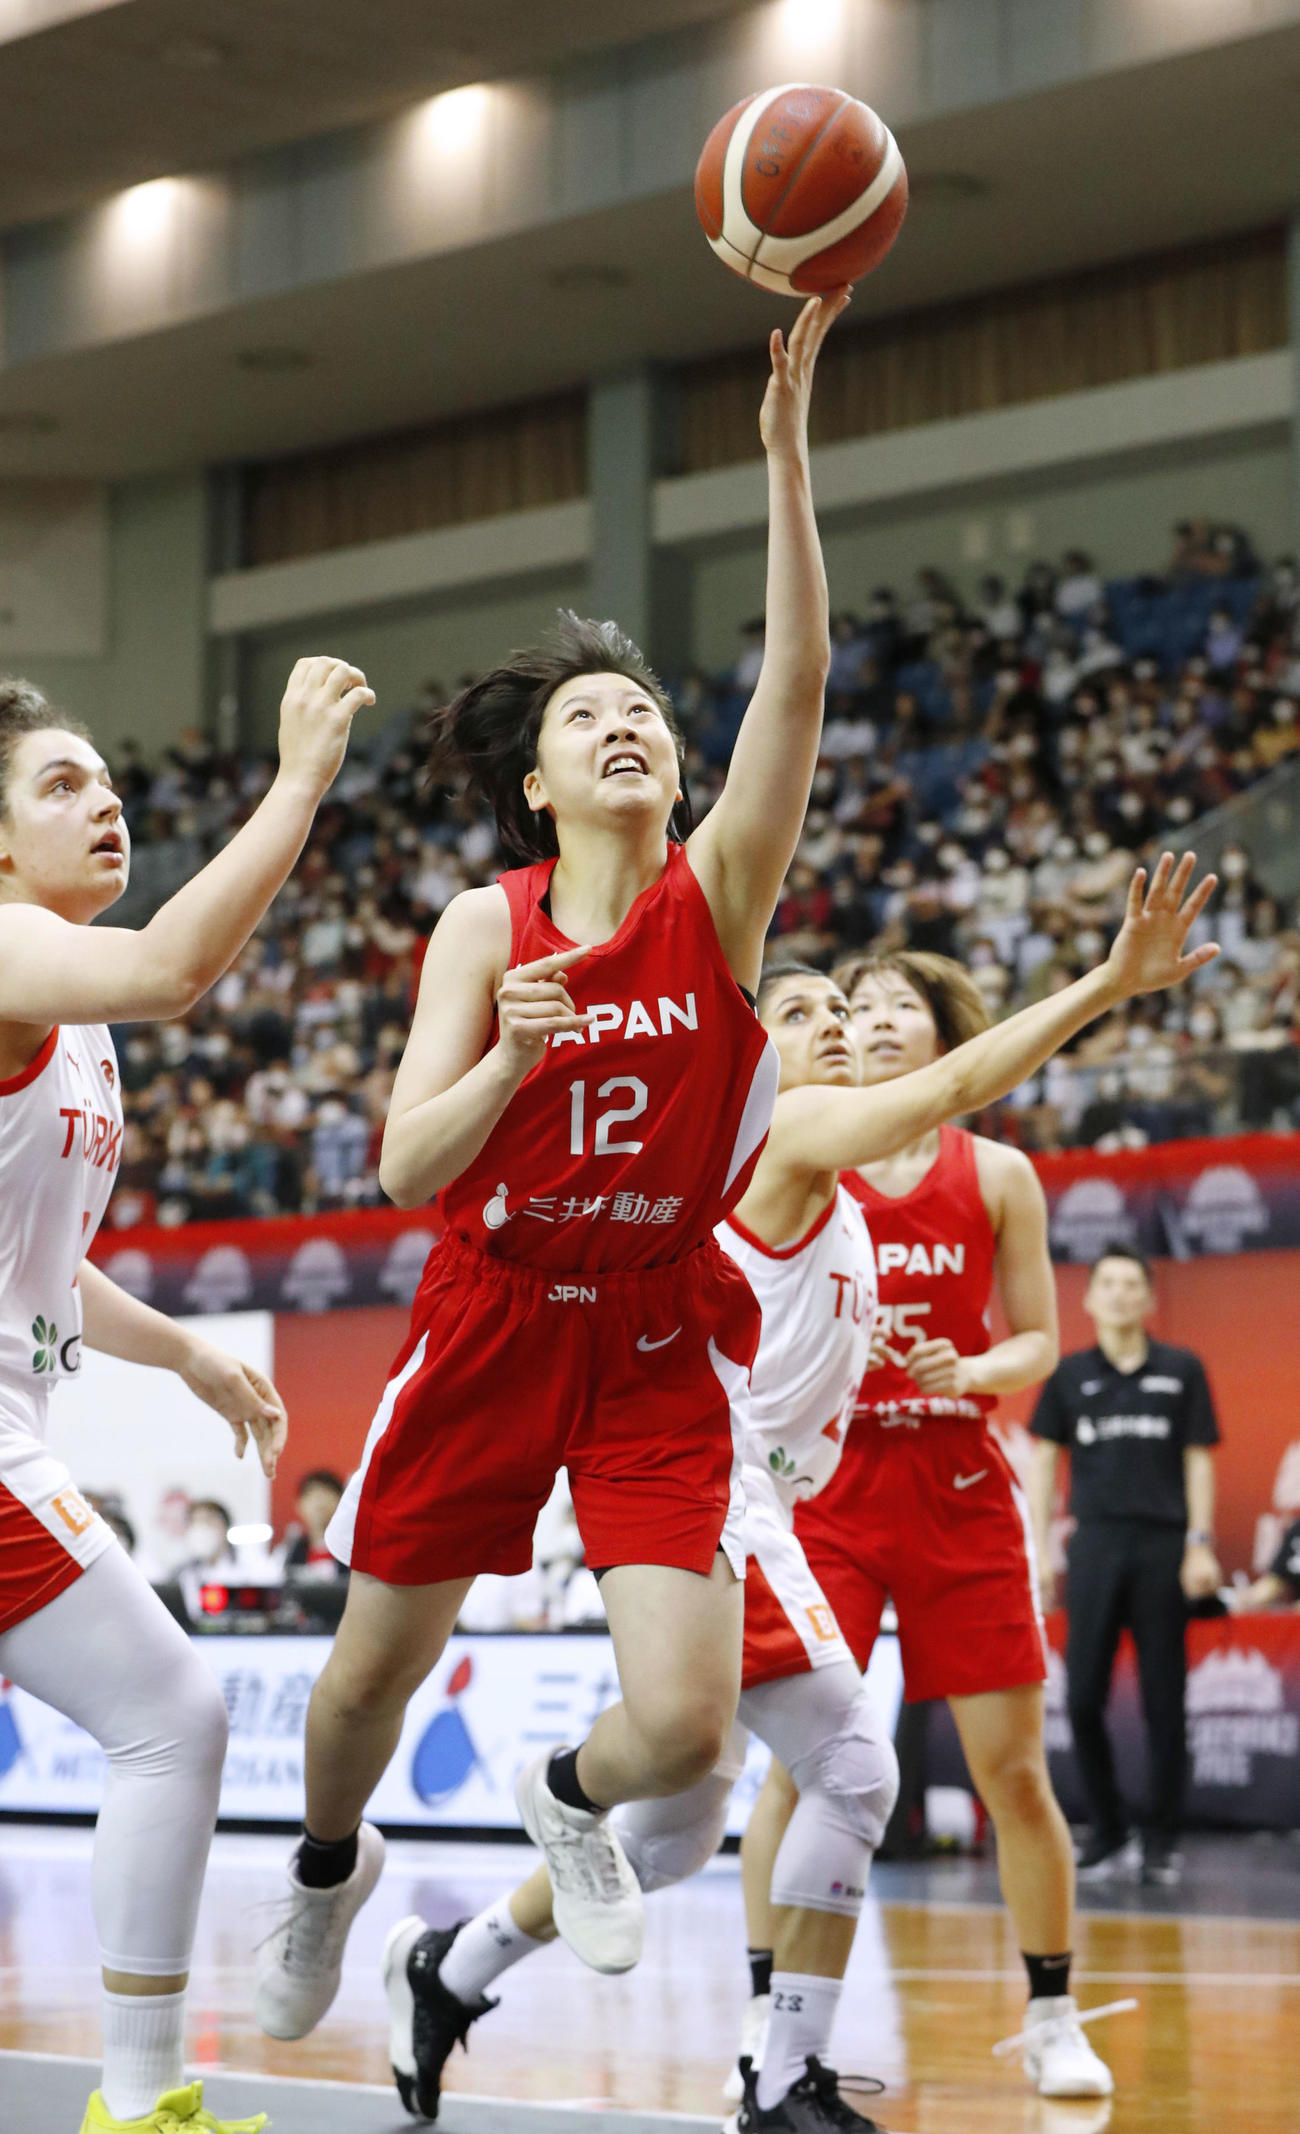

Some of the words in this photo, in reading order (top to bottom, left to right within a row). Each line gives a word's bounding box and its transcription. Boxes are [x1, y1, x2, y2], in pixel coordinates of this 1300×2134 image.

[544, 992, 699, 1048] PAN
[59, 1098, 122, 1173] TÜRK
[569, 1075, 649, 1156] 12
[877, 1242, 966, 1276] PAN
[548, 1285, 597, 1303] JPN
[774, 1992, 804, 2013] 23
